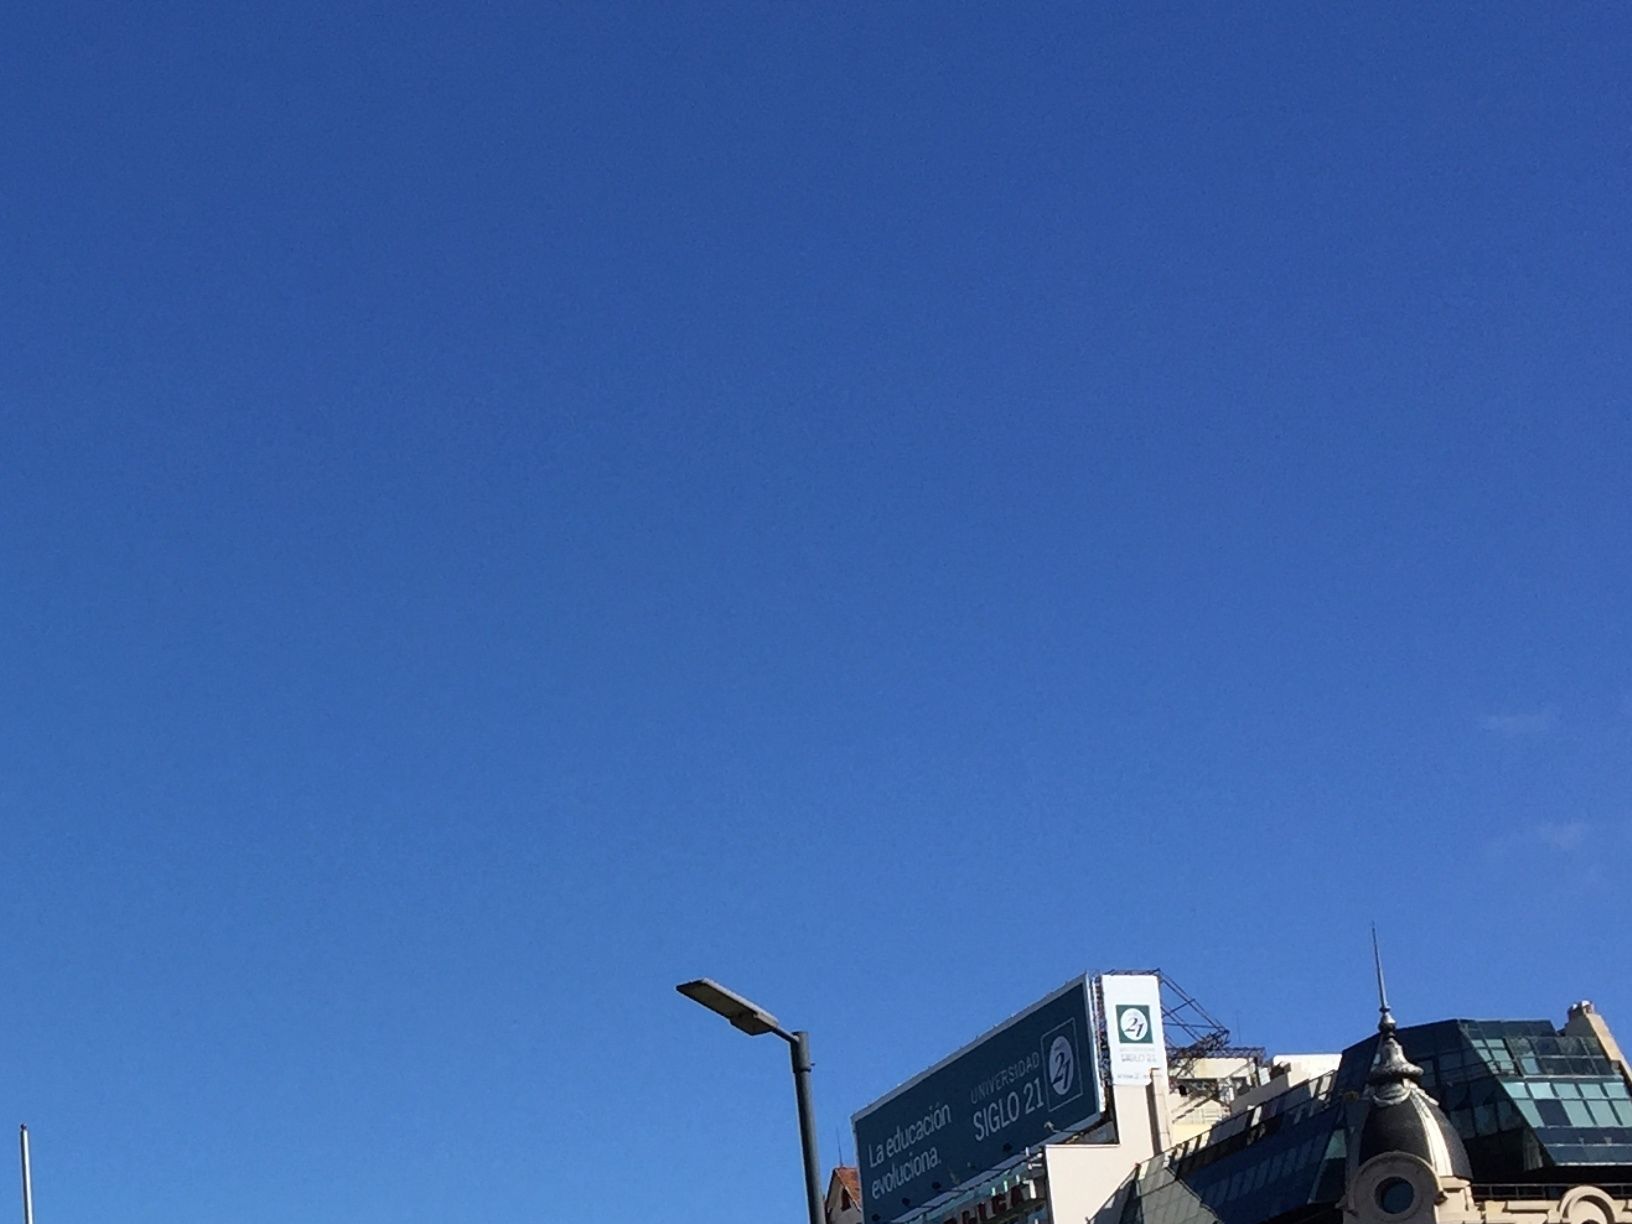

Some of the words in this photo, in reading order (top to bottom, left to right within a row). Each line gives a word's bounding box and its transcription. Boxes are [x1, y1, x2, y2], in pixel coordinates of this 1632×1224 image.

[969, 1051, 1040, 1105] UNIVERSIDAD
[868, 1141, 885, 1169] La
[885, 1102, 953, 1159] educación
[972, 1091, 1019, 1142] SIGLO
[1022, 1077, 1045, 1114] 21
[871, 1145, 941, 1201] evoluciona.
